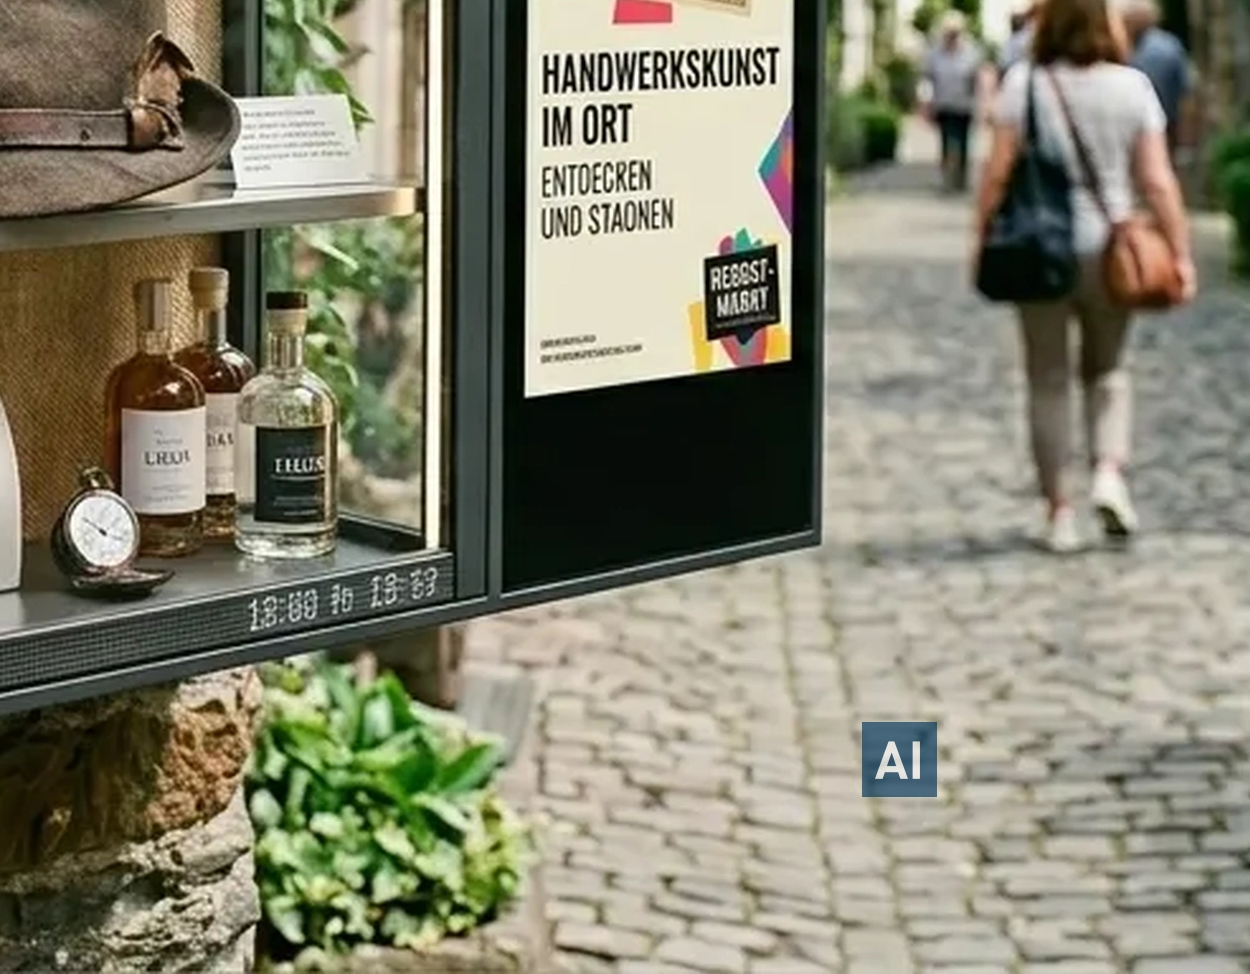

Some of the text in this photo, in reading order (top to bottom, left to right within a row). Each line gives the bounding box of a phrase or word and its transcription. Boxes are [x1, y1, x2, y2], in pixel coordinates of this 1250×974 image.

[542, 47, 780, 95] HANDWERKSKUNST
[542, 103, 633, 147] IM ORT
[541, 204, 582, 240] UND
